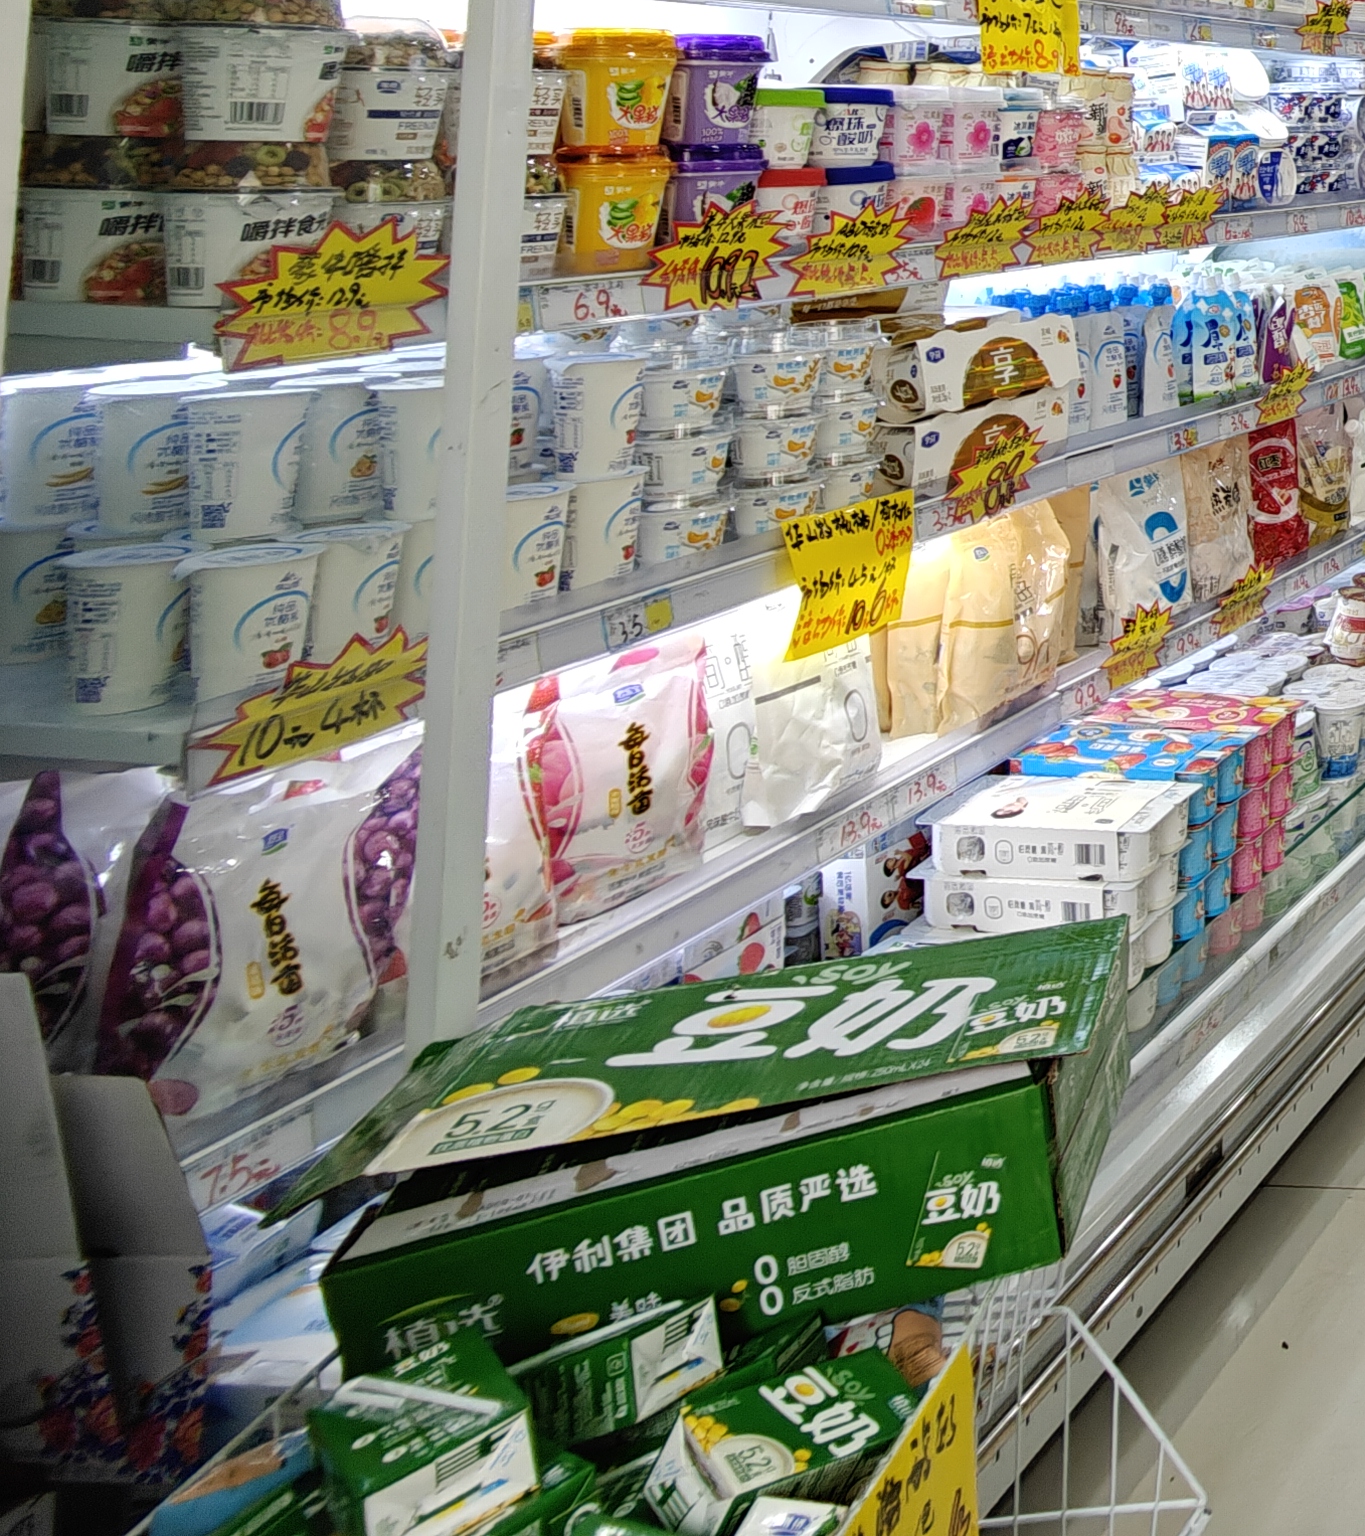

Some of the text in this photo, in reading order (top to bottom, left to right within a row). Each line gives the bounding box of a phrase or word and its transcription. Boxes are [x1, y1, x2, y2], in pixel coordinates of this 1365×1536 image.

[616, 104, 659, 125] 大果粒
[710, 104, 750, 124] 大果粒
[609, 222, 653, 244] 大果粒
[619, 722, 653, 816] 每日活菌
[249, 878, 303, 996] 每日活菌
[605, 977, 997, 1068] 豆奶
[965, 995, 1067, 1037] 豆奶
[525, 1164, 878, 1286] 伊利集团 品质严选
[921, 1180, 1000, 1227] 豆奶
[753, 1242, 850, 1286] 0 胆固醇
[758, 1267, 876, 1317] 0 反式脂肪
[758, 1366, 880, 1459] 豆奶
